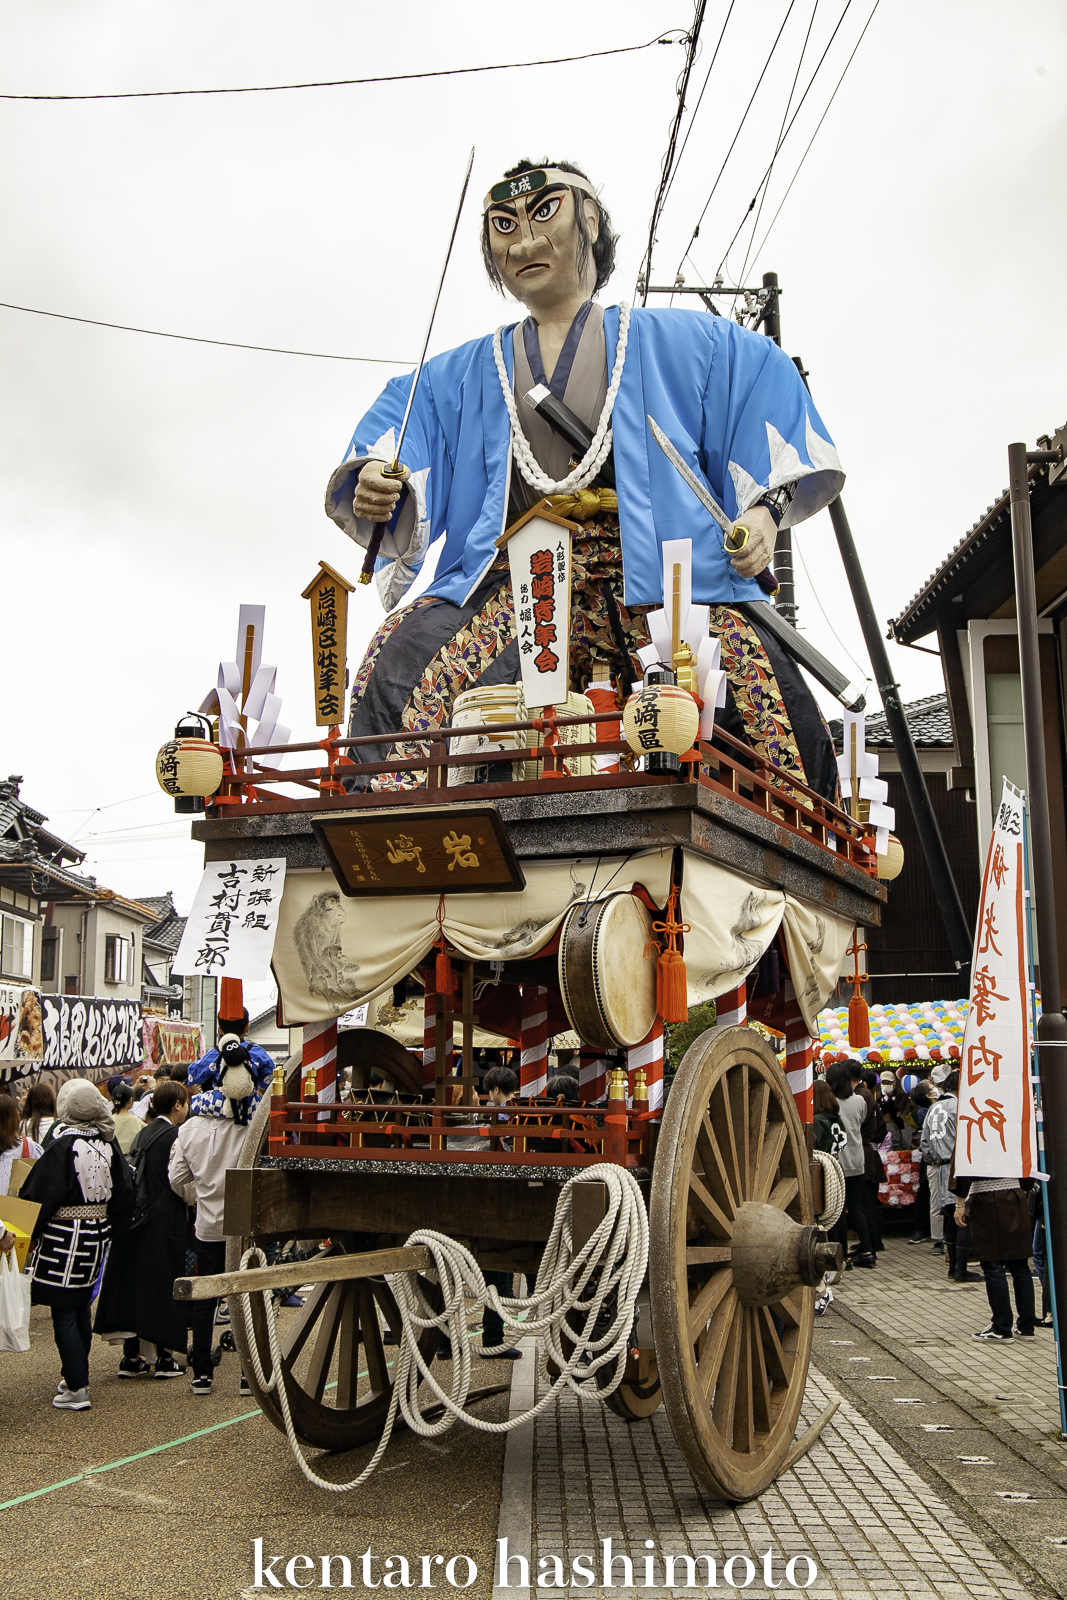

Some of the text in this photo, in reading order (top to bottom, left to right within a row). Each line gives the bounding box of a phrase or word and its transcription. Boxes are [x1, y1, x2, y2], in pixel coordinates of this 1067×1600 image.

[509, 175, 532, 197] 誠
[195, 863, 248, 975] 吉村貫一郎
